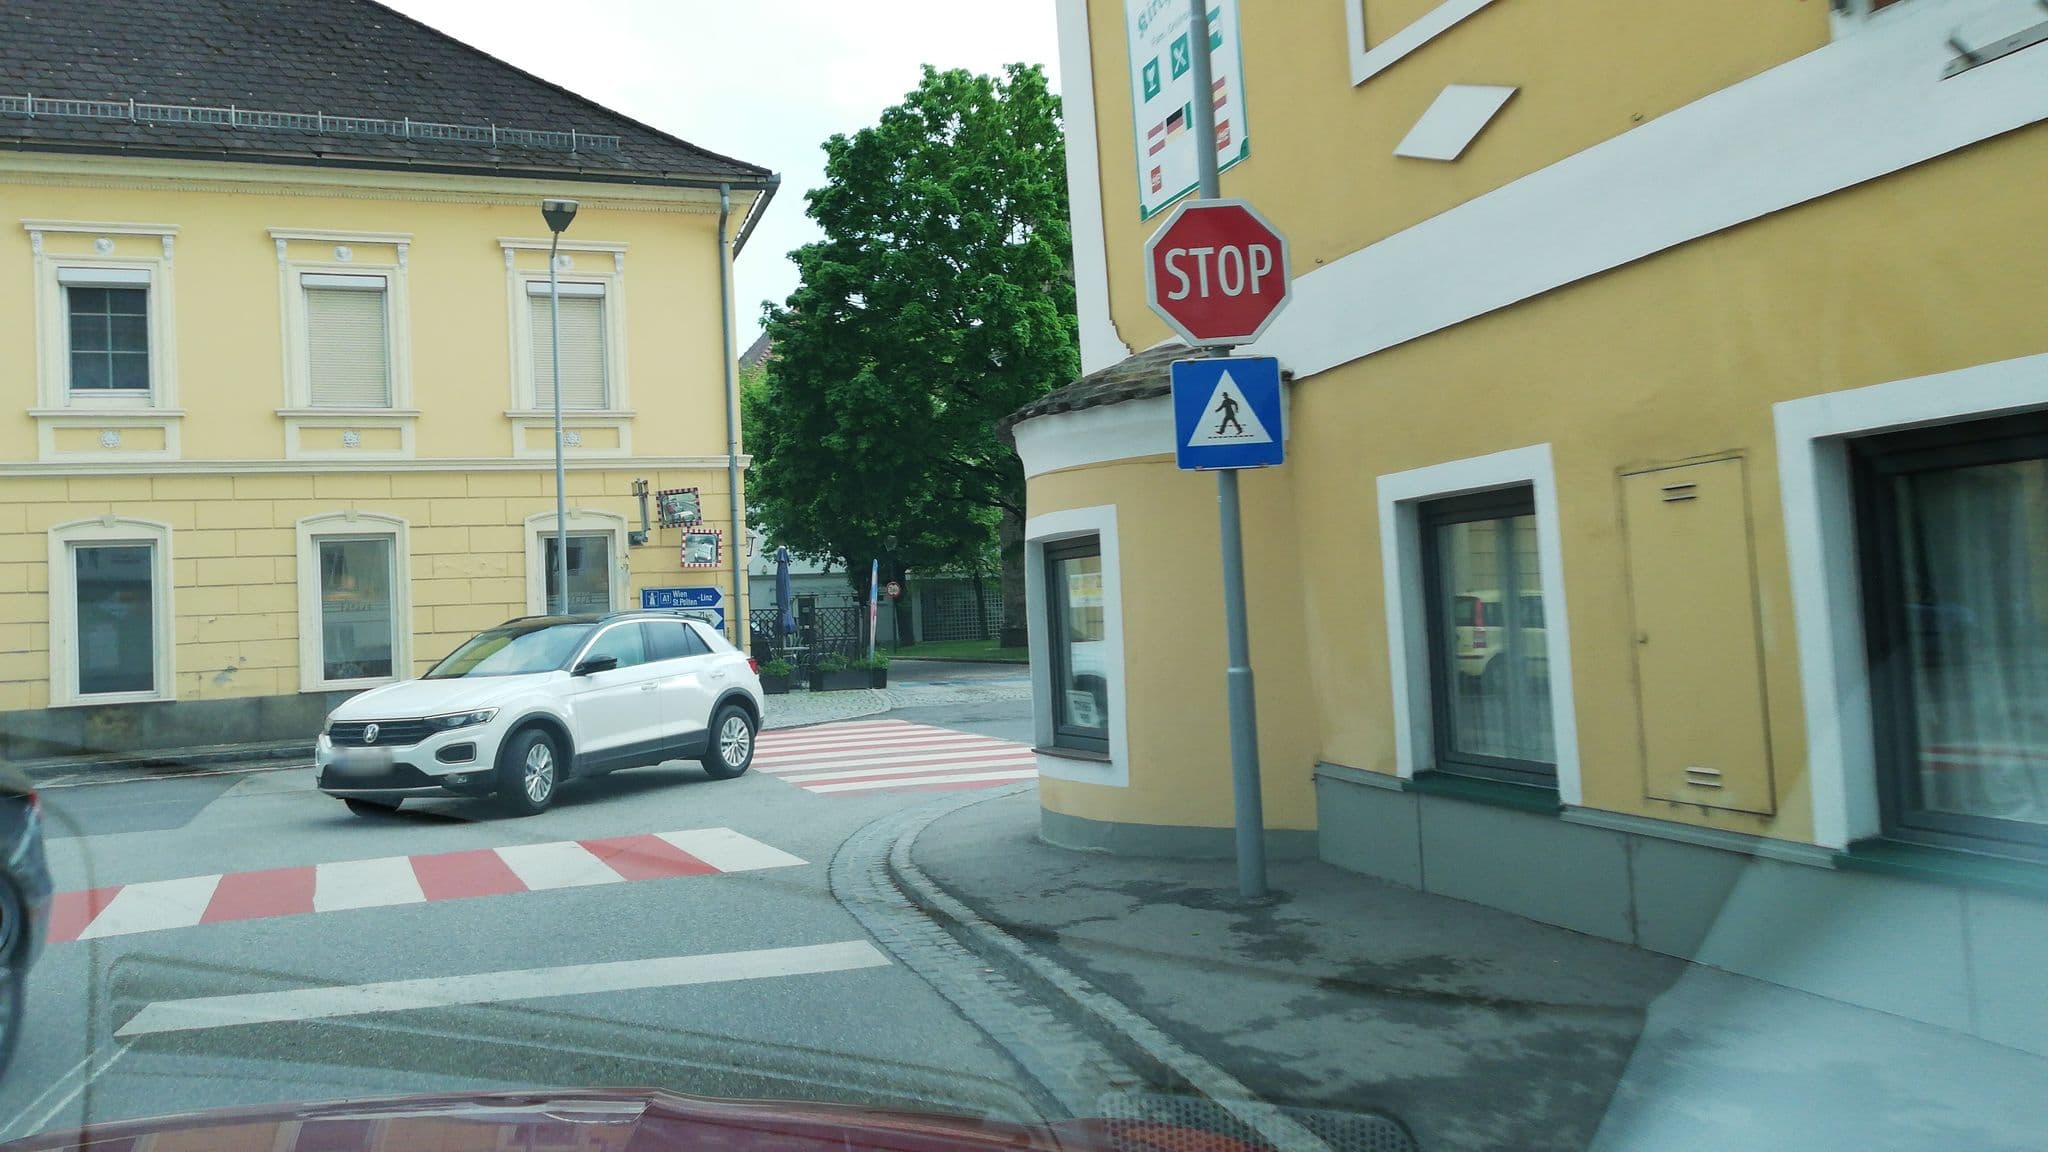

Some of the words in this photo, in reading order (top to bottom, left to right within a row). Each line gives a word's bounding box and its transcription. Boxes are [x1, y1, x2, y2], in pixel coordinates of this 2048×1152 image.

[1165, 244, 1273, 301] STOP
[662, 594, 670, 602] A1
[672, 590, 688, 598] Wien
